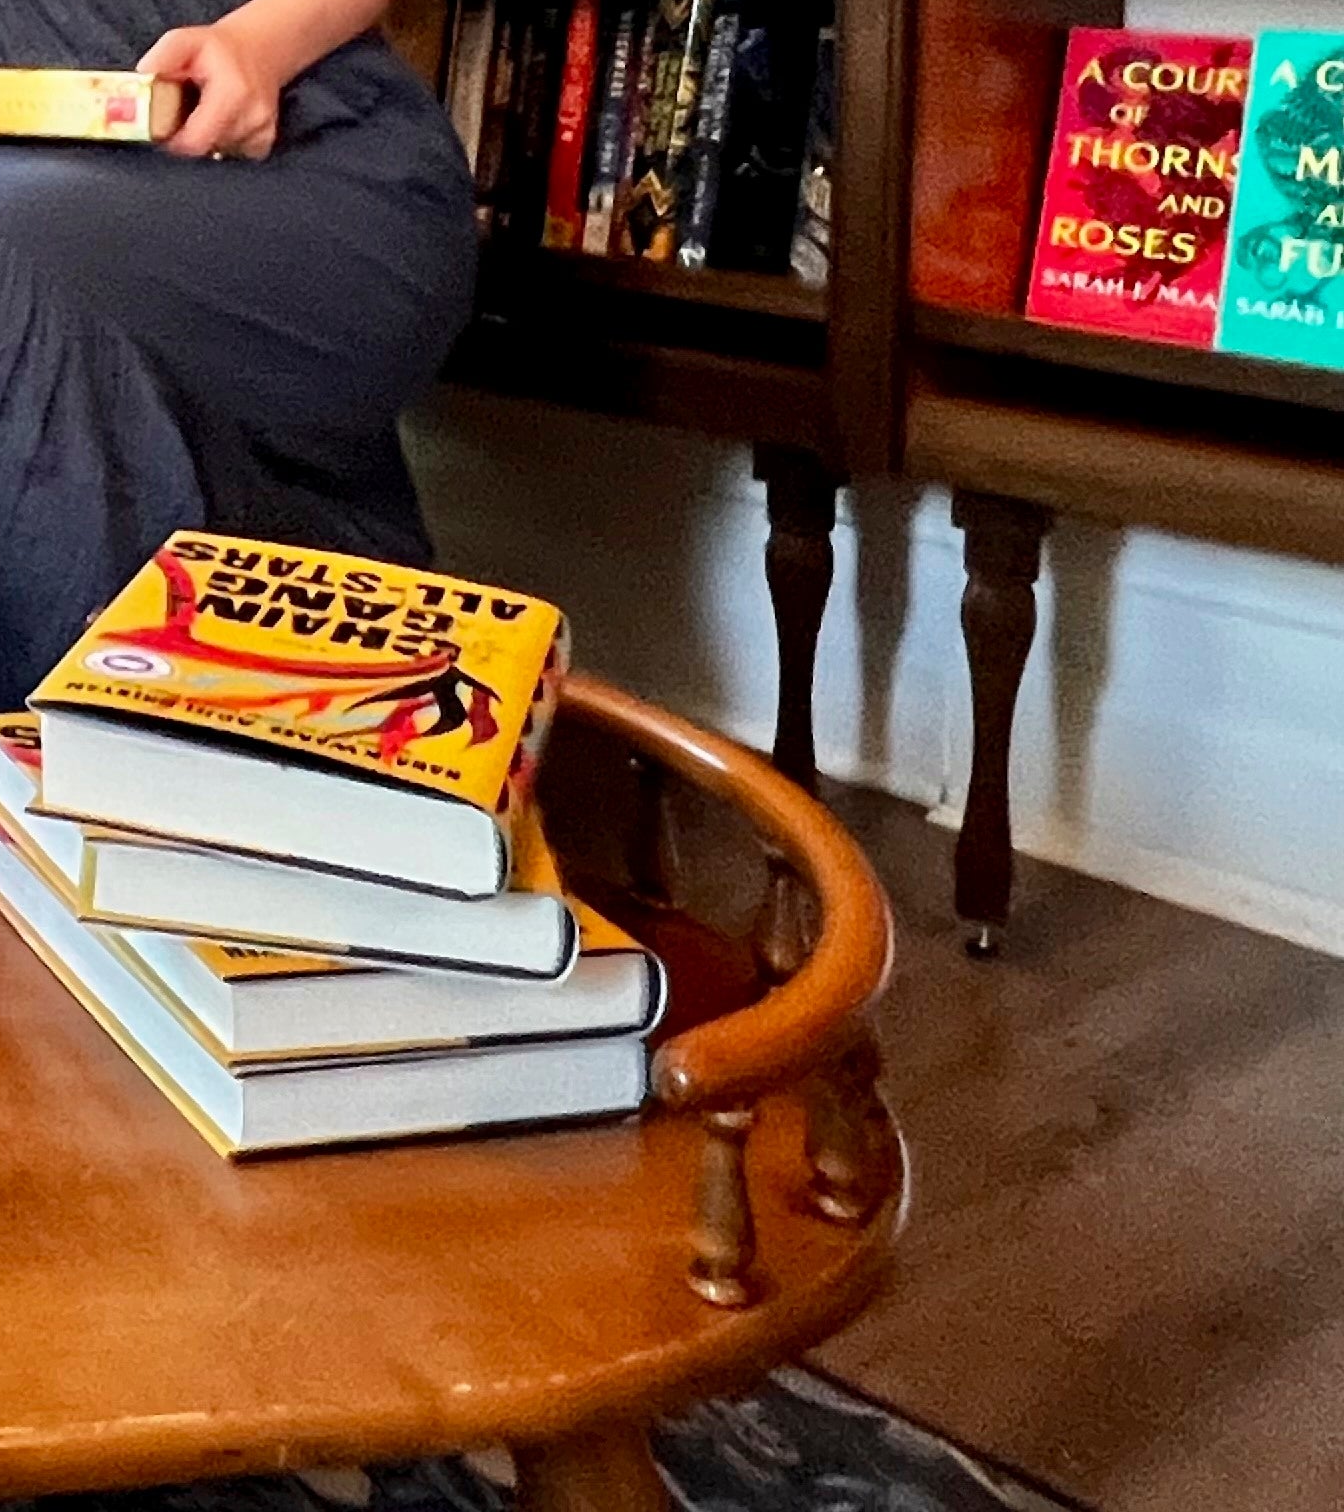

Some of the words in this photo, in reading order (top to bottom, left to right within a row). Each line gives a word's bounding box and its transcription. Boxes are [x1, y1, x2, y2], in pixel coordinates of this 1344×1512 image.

[1077, 57, 1106, 87] A
[1123, 61, 1244, 96] COUR
[1268, 58, 1299, 90] A
[1109, 102, 1150, 126] OF
[1157, 193, 1226, 219] AND
[1050, 216, 1197, 265] ROSES
[1279, 235, 1344, 279] FU
[1041, 268, 1124, 296] SARAH
[1156, 285, 1218, 310] MAA
[207, 570, 454, 634] GANG
[196, 592, 464, 662] CHAIN
